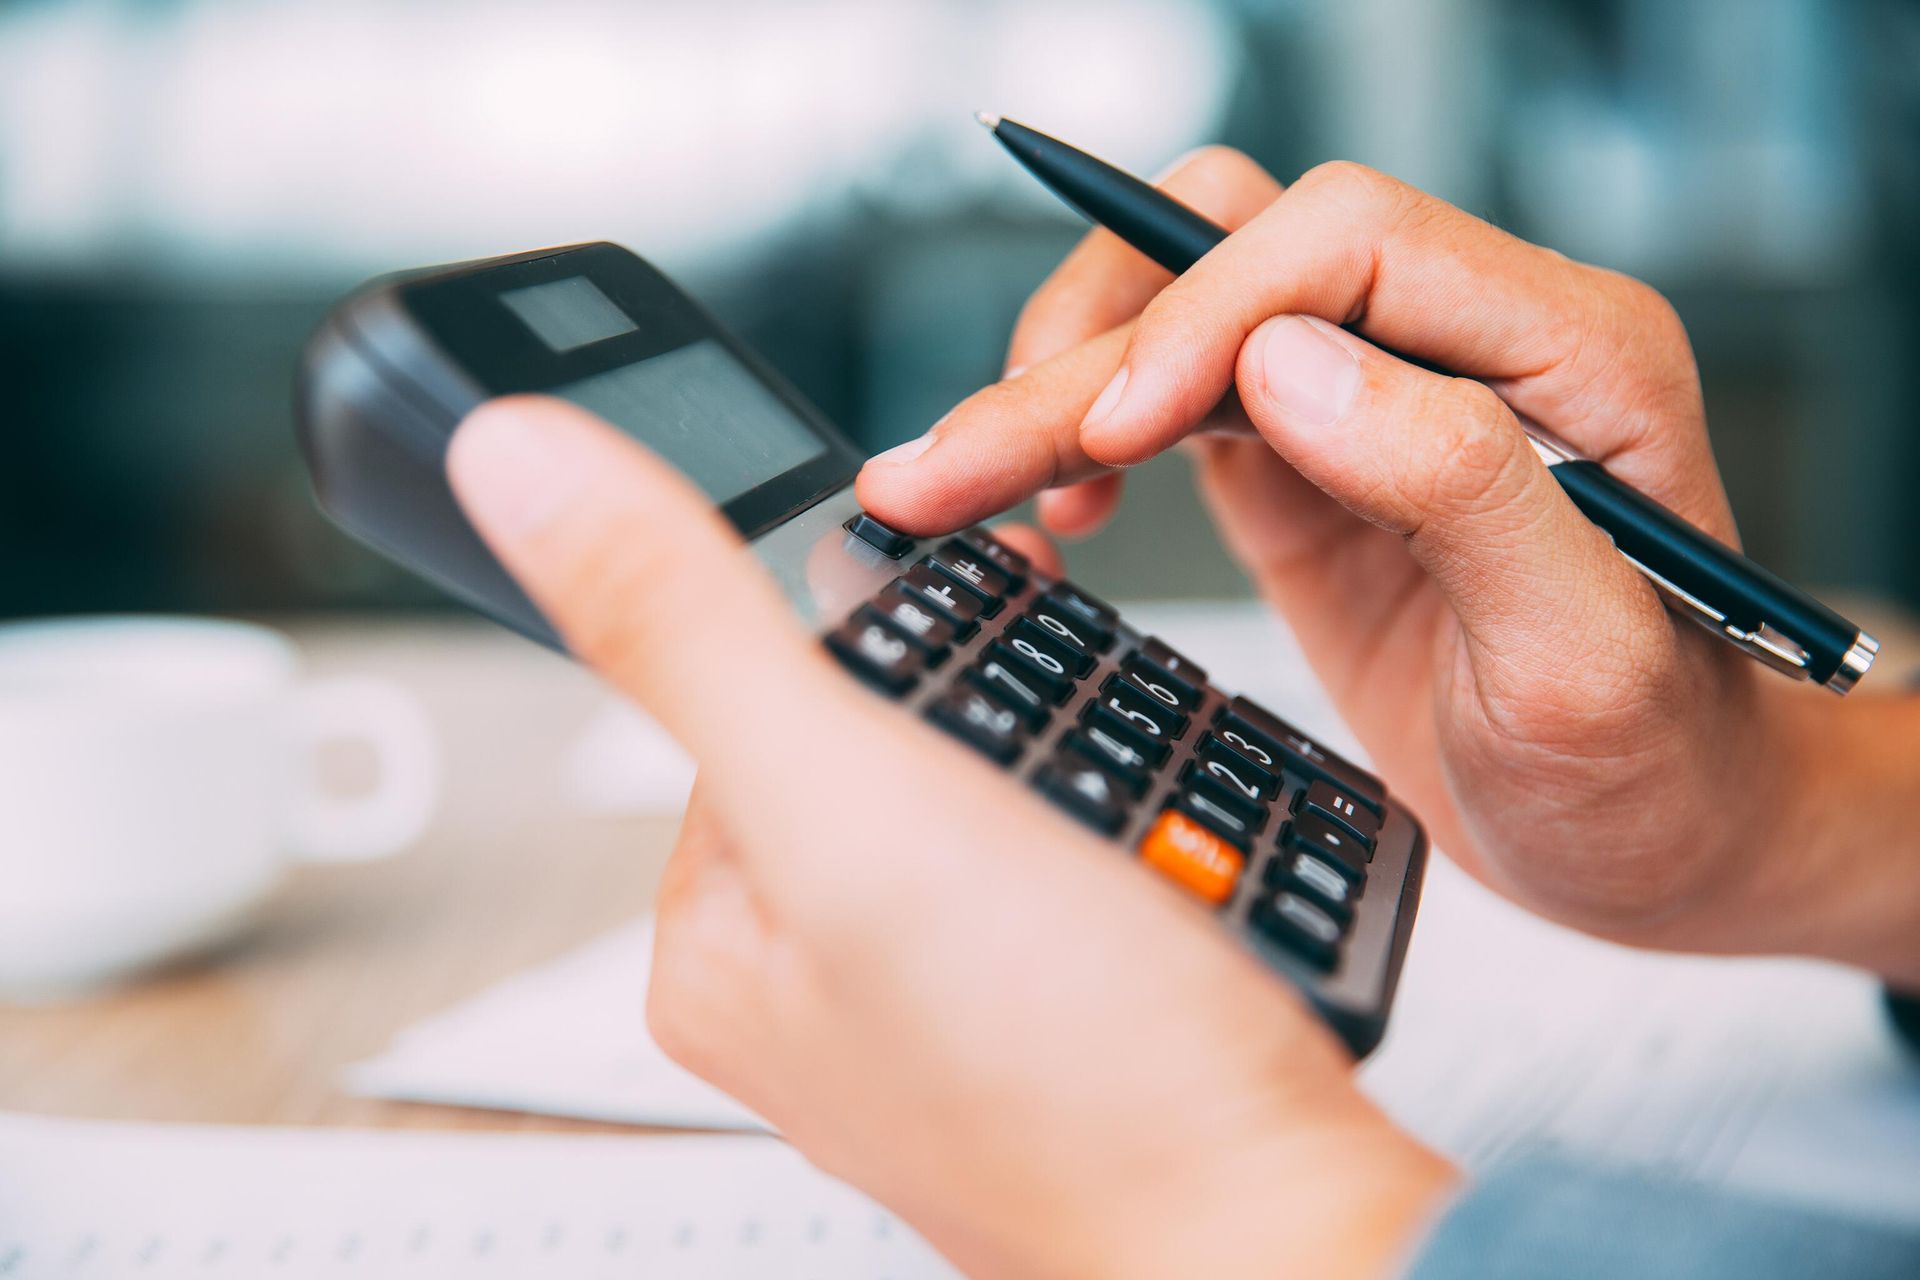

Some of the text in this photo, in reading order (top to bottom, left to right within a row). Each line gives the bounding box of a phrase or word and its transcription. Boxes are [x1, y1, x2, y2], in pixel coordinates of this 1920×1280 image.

[1037, 614, 1085, 647] 9
[1012, 638, 1064, 674] 8
[983, 661, 1041, 706] 7
[1131, 672, 1180, 706] 6
[1109, 697, 1162, 736] 5
[1088, 726, 1145, 767] 4
[1223, 730, 1272, 765] 3
[1207, 760, 1260, 800] 2
[1187, 790, 1246, 833] 1
